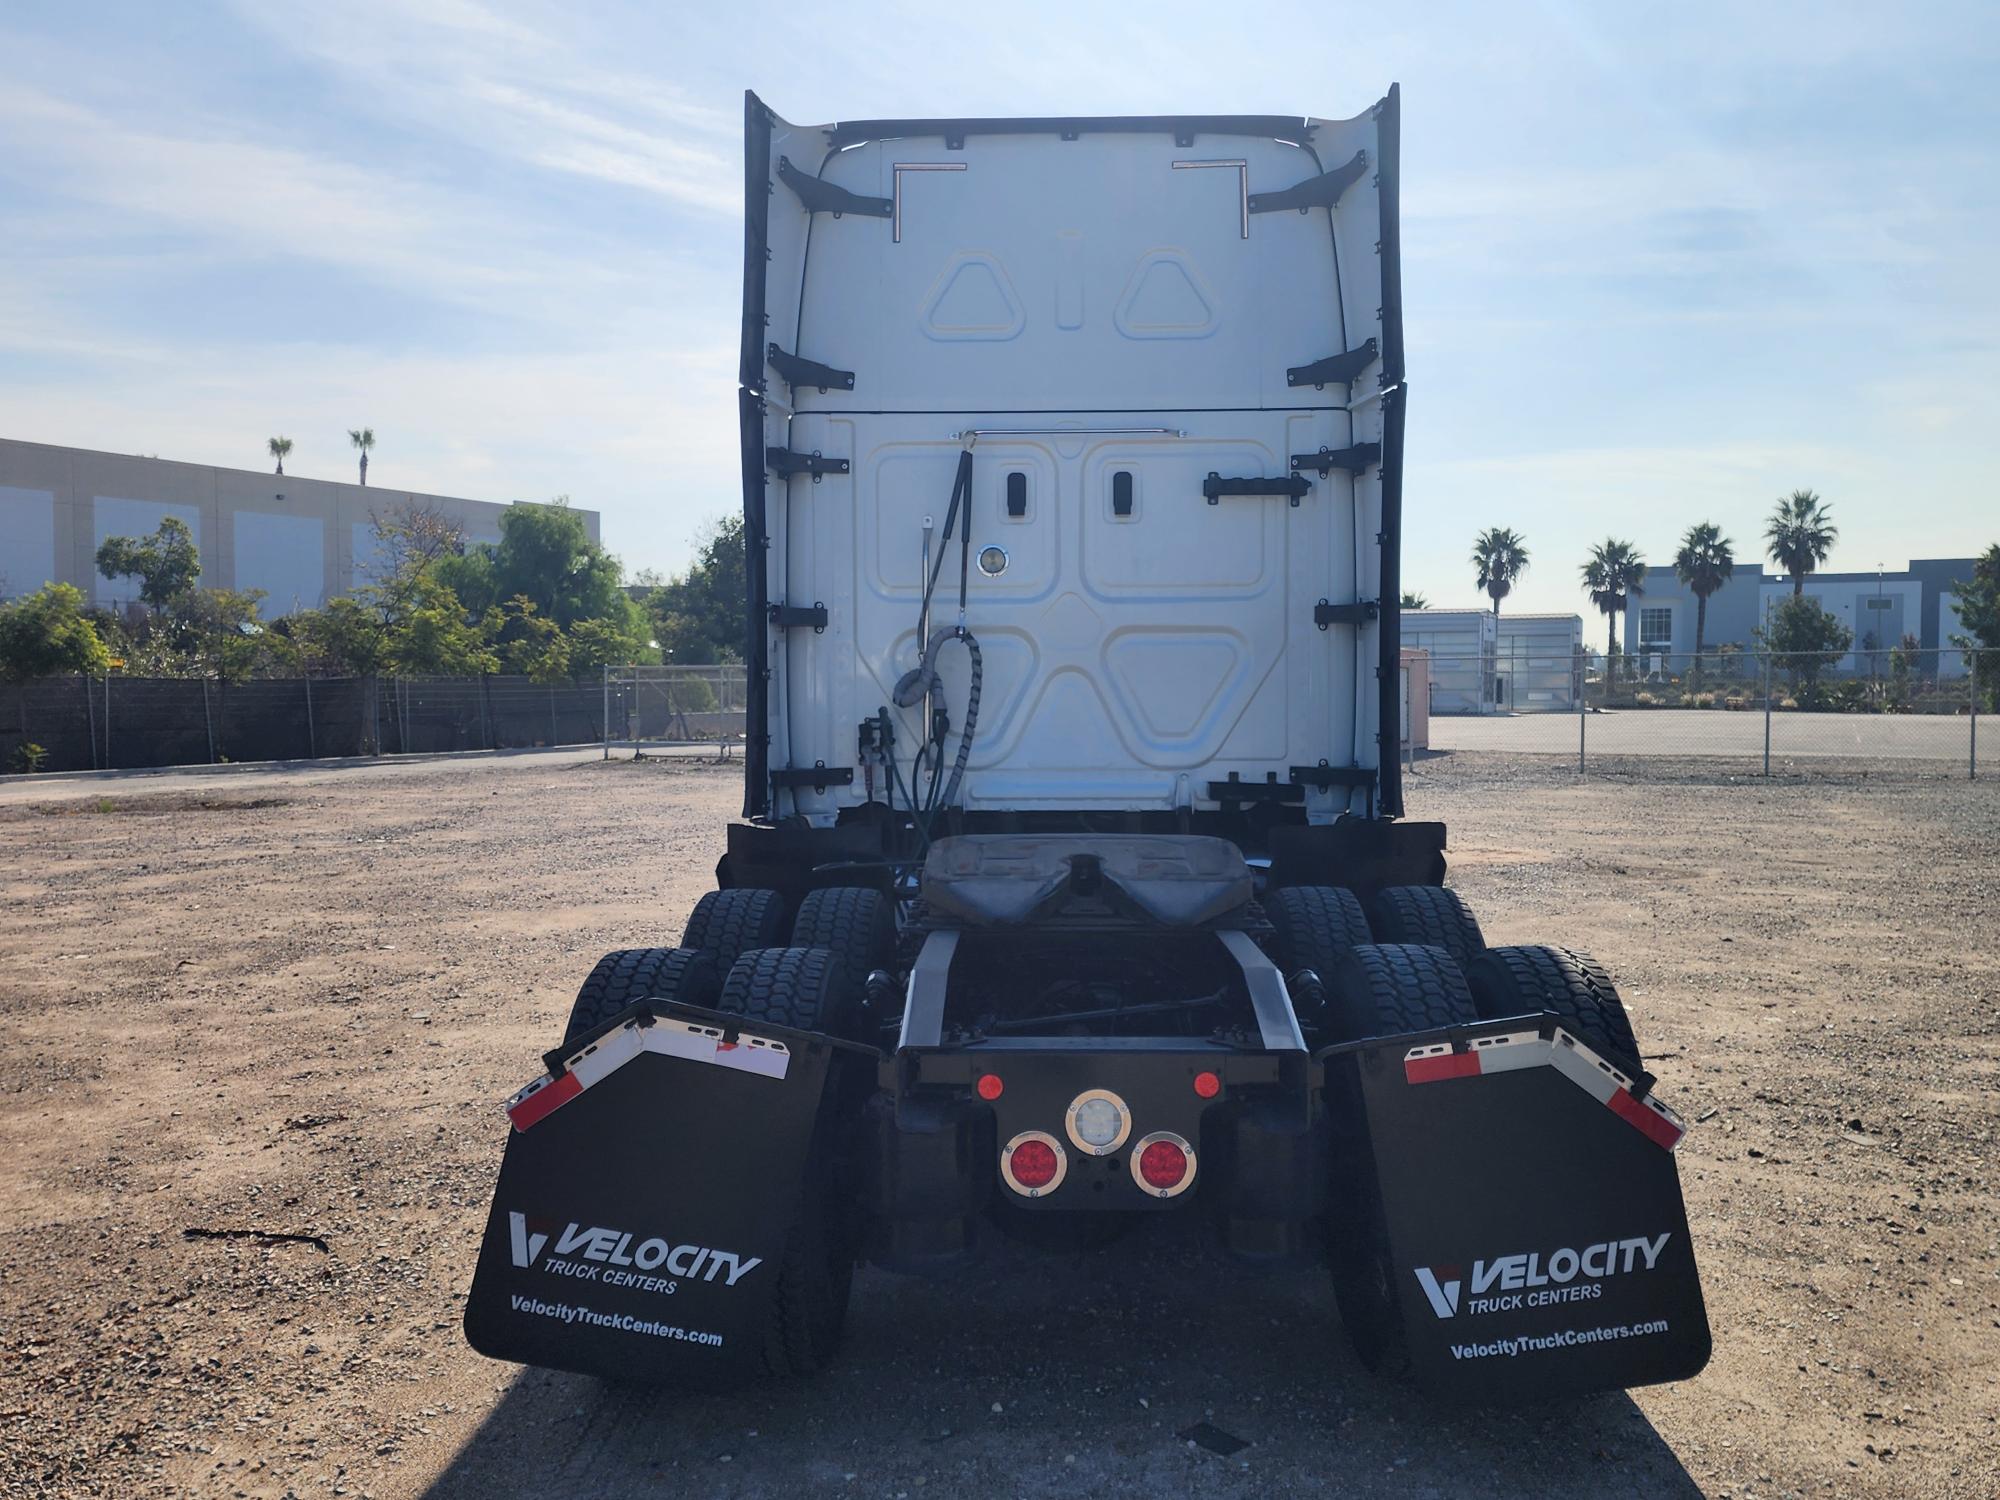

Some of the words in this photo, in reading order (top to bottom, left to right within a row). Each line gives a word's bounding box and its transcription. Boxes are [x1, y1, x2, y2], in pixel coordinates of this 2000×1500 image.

[544, 1258, 601, 1280] TRUCK
[602, 1270, 678, 1295] CENTERS
[554, 1222, 763, 1286] VELOCITY
[1470, 1233, 1672, 1294] VELOCITY
[511, 1294, 723, 1347] VelocityTruckCenters.com
[1468, 1294, 1523, 1315] TRUCK
[1527, 1284, 1602, 1307] CENTERS
[1451, 1319, 1669, 1360] VelocityTruckCenters.com
